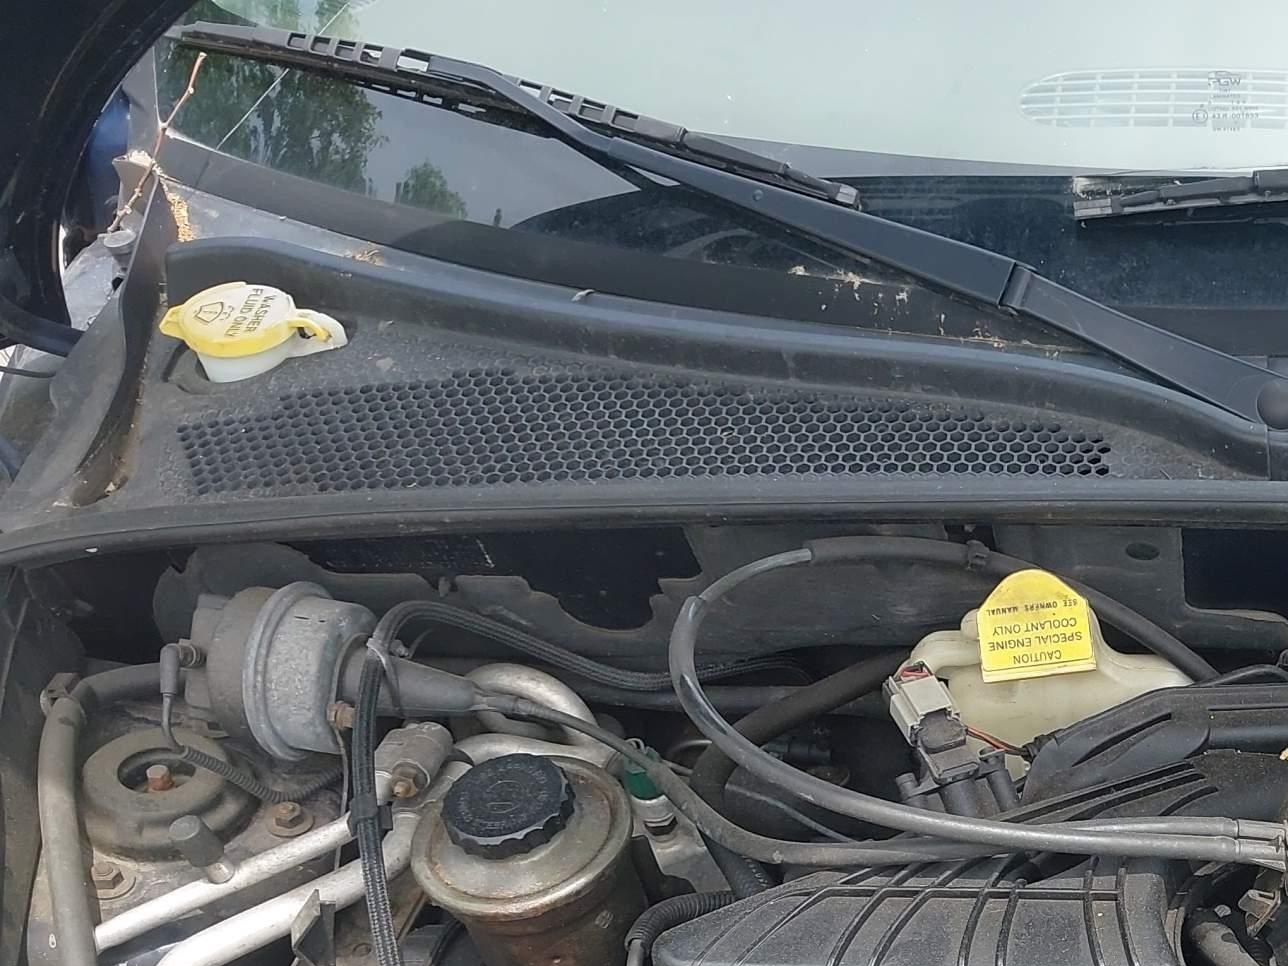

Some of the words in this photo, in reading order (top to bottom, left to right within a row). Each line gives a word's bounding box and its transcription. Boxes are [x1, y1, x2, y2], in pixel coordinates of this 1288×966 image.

[239, 288, 263, 313] FLUID
[244, 294, 277, 333] WASHER
[224, 315, 244, 337] ONLY
[1064, 598, 1078, 606] SEE
[986, 606, 1018, 616] MANUAL
[993, 624, 1021, 637] ONLY
[1025, 617, 1077, 632] COOLANT
[1035, 631, 1082, 644] SPECIAL
[988, 638, 1032, 651] ENGINE
[1013, 650, 1062, 664] CAUTION
